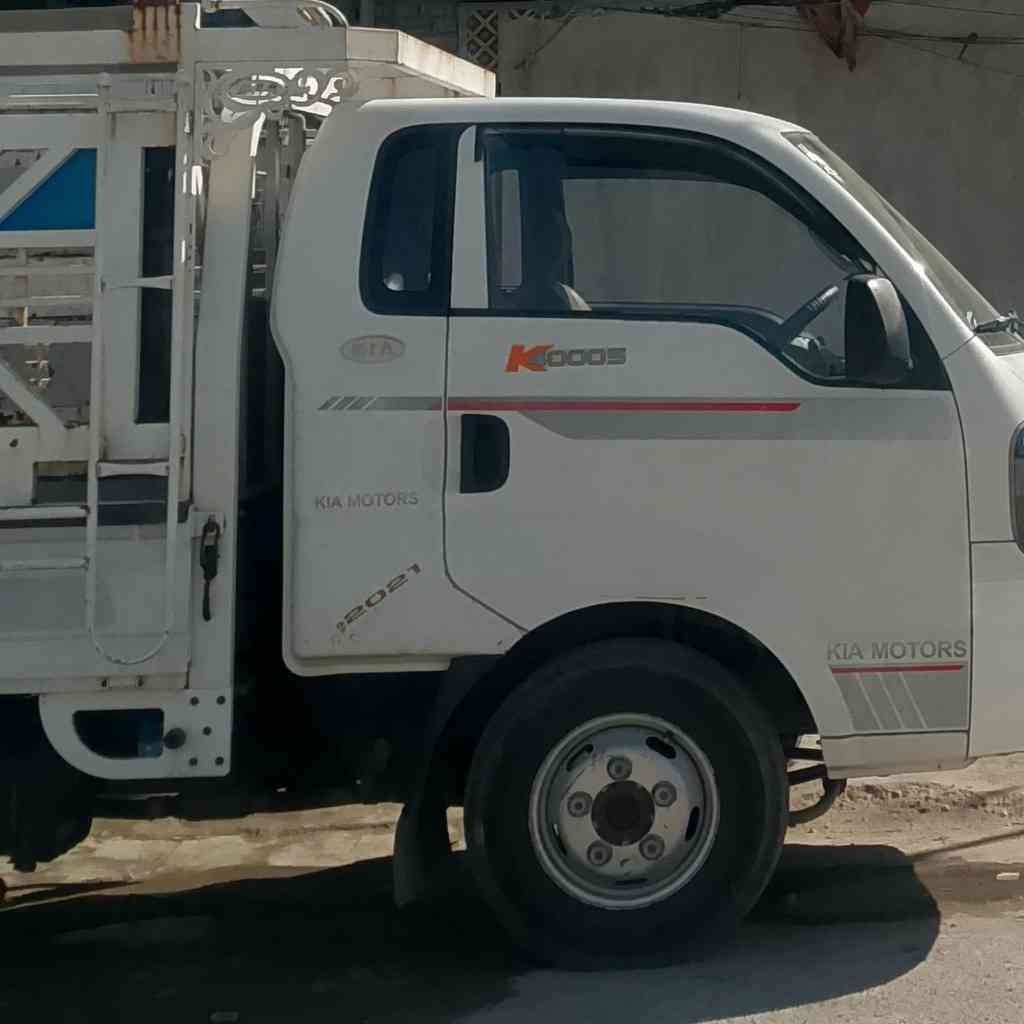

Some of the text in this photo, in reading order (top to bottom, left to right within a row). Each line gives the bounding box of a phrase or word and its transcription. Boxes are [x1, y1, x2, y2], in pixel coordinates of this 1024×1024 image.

[314, 492, 419, 509] KIA MOTORS
[826, 639, 968, 660] KIA MOTORS
